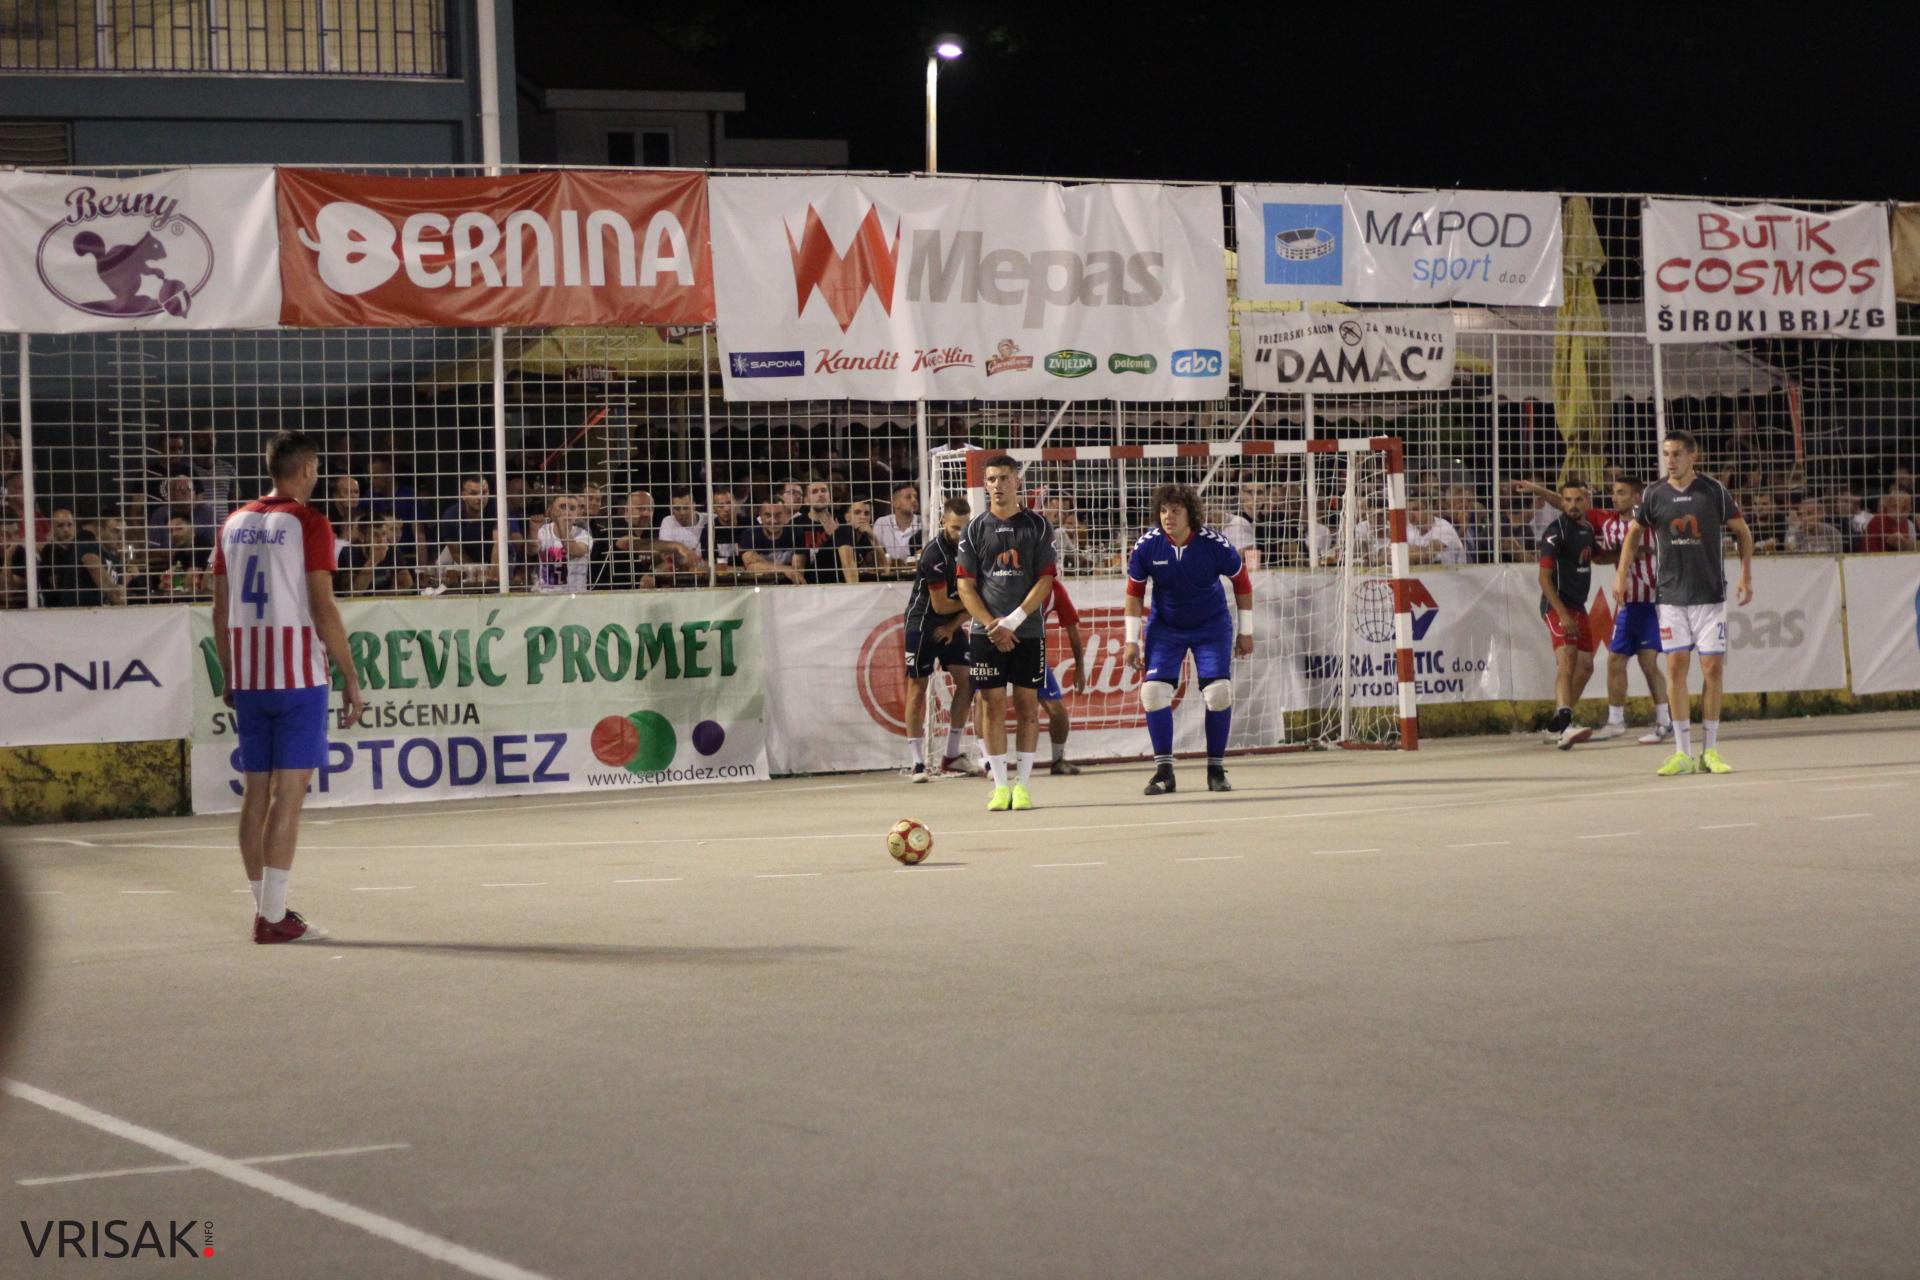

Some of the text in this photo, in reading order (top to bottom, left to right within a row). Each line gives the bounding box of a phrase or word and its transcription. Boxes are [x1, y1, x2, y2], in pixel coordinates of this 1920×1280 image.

[65, 187, 179, 230] Berny
[1365, 209, 1532, 248] MAPOD
[299, 202, 695, 295] BERNINA
[906, 229, 1164, 329] Mepas
[1412, 253, 1492, 288] sport
[1656, 257, 1881, 296] COSMOS
[1657, 304, 1885, 332] ŠIROKI BRIJEG
[1258, 322, 1444, 345] FRIZERSKI SALON ZA MUŠKARCE
[750, 360, 803, 370] SAPONIA
[814, 348, 900, 375] Kandit
[1048, 357, 1093, 372] ZVIJEZDA
[1114, 358, 1151, 370] paloma
[1174, 351, 1219, 375] abc
[241, 555, 269, 619] 4
[523, 618, 745, 685] PROMET
[1332, 678, 1465, 699] AUTODIELOVI
[357, 700, 481, 729] ČIŠĆENJA
[228, 733, 570, 797] PTODEZ
[586, 763, 756, 786] www.septodez.com
